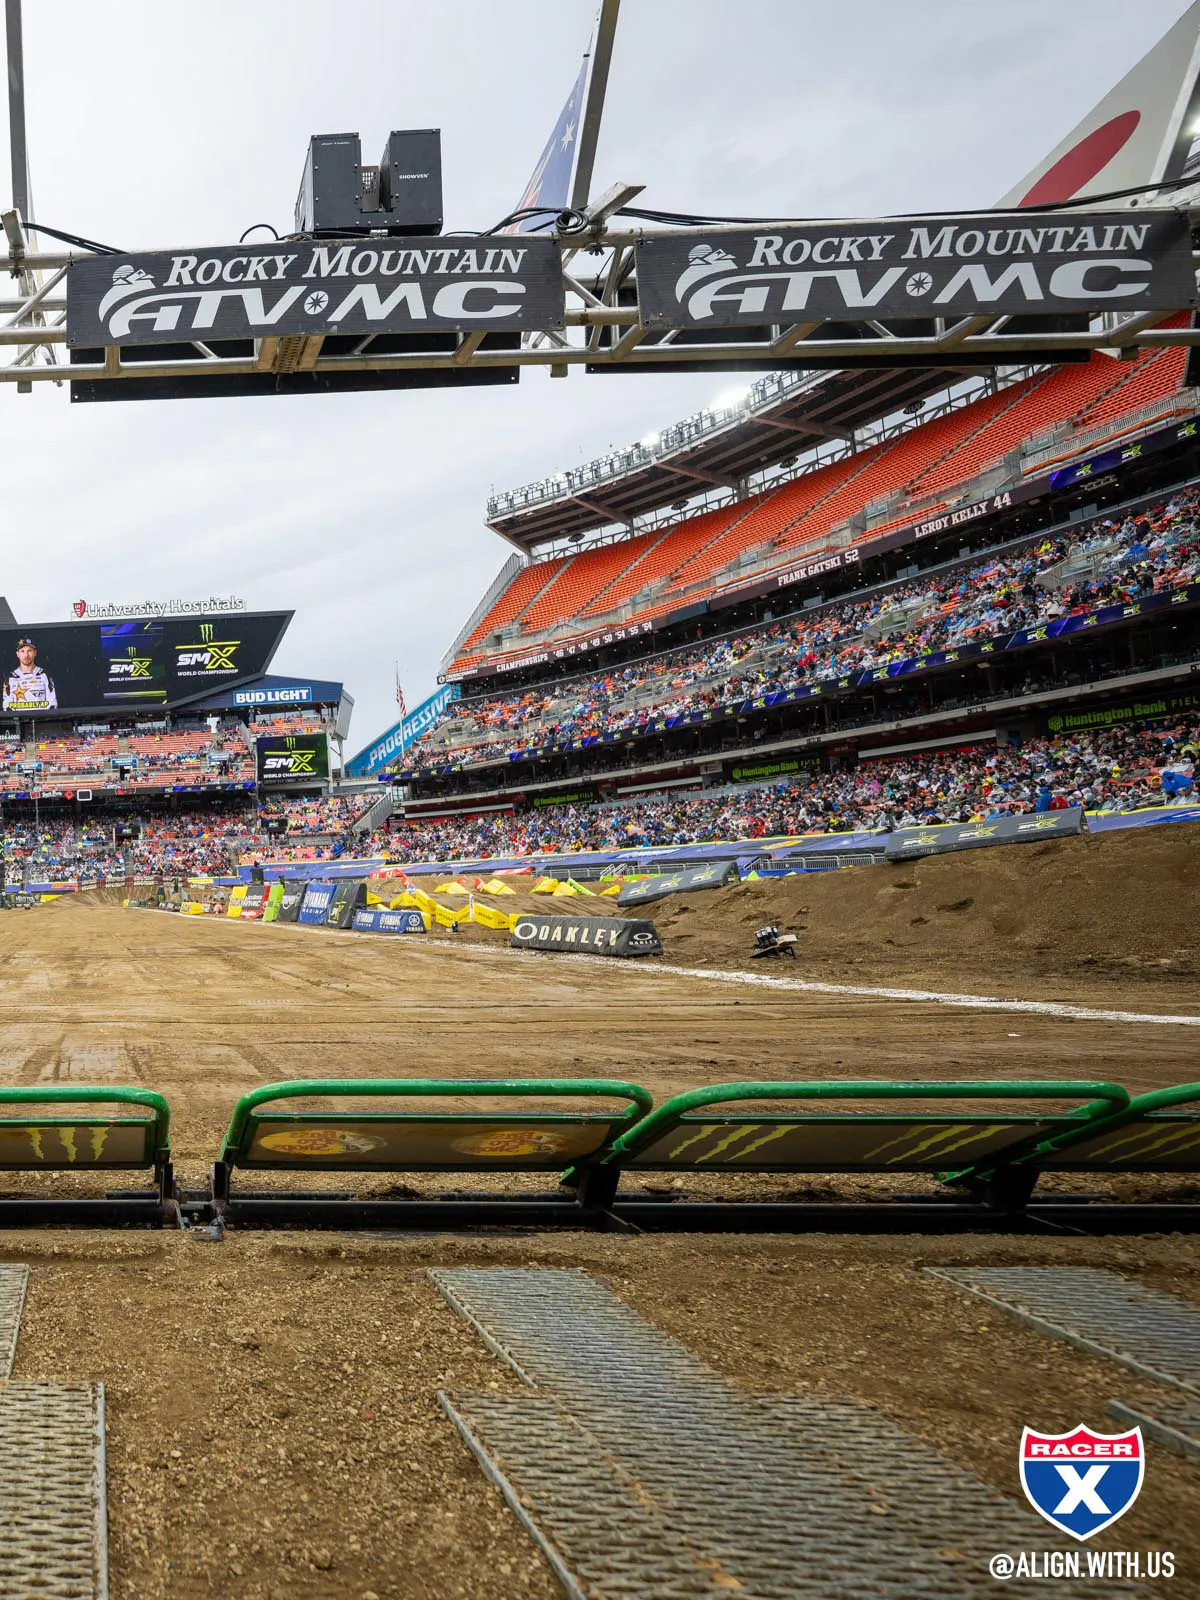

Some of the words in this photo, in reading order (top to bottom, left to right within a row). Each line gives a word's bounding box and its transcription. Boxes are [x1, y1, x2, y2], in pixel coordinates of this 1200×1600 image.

[746, 234, 895, 266] ROCKY
[901, 224, 1151, 260] MOUNTAIN
[163, 254, 297, 286] ROCKY
[302, 246, 527, 278] MOUNTAIN
[914, 516, 949, 538] LEROY
[951, 501, 988, 525] KELLY
[993, 492, 1012, 509] 44
[777, 567, 807, 586] FRANK
[808, 556, 841, 575] GATSKI
[845, 549, 860, 563] 52
[87, 602, 166, 618] University
[170, 595, 243, 615] Hospitals
[109, 661, 150, 677] SMX
[176, 646, 238, 670] SMX
[497, 653, 548, 672] CHAMPIONSHIPS
[567, 645, 576, 655] '47
[236, 692, 265, 703] BUD
[268, 690, 308, 701] LIGHT
[1065, 707, 1133, 727] Huntington
[1134, 701, 1166, 716] Bank
[1172, 697, 1200, 708] FIEL
[264, 754, 314, 772] SMX
[538, 925, 622, 946] OAKLEY
